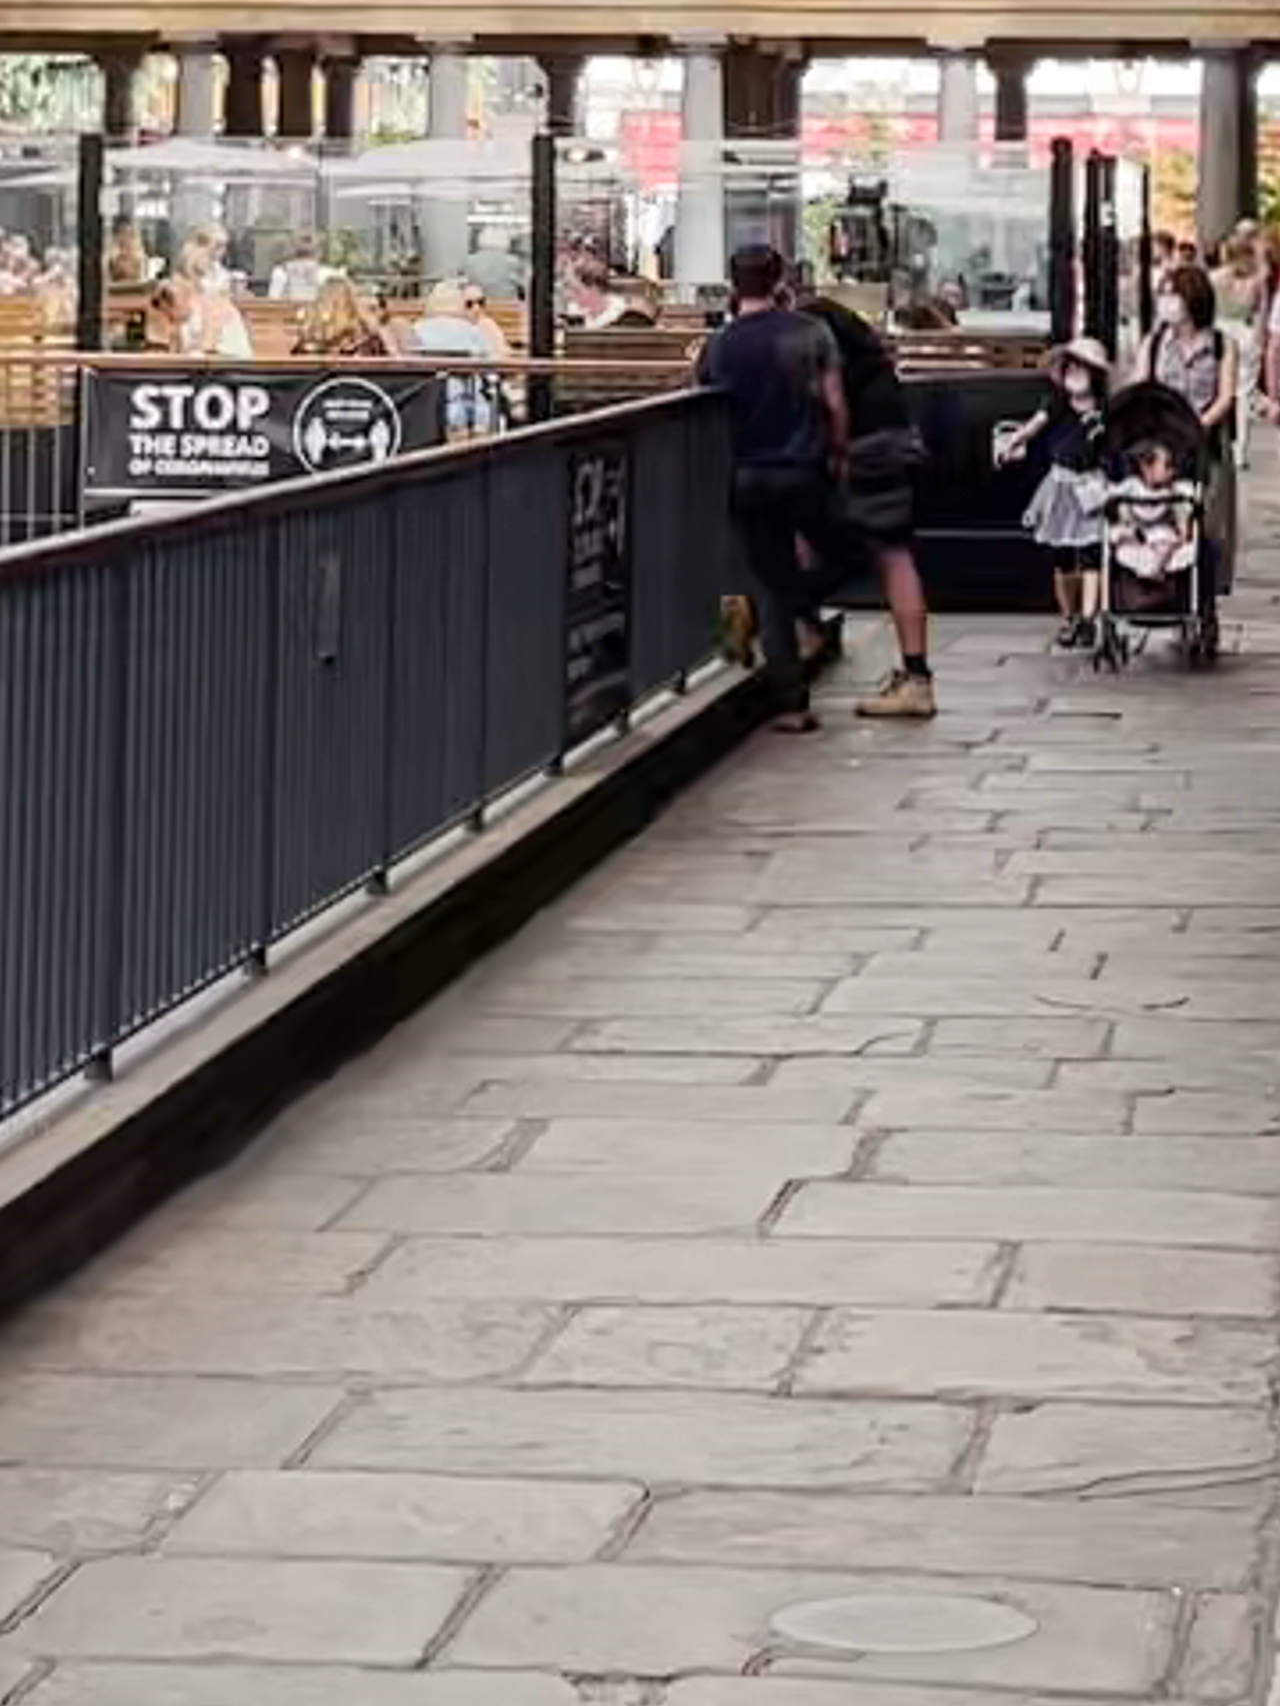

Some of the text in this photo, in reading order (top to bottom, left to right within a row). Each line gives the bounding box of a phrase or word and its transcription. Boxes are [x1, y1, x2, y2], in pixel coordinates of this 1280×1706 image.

[130, 385, 270, 430] STOP
[129, 435, 270, 457] THE SPREAD
